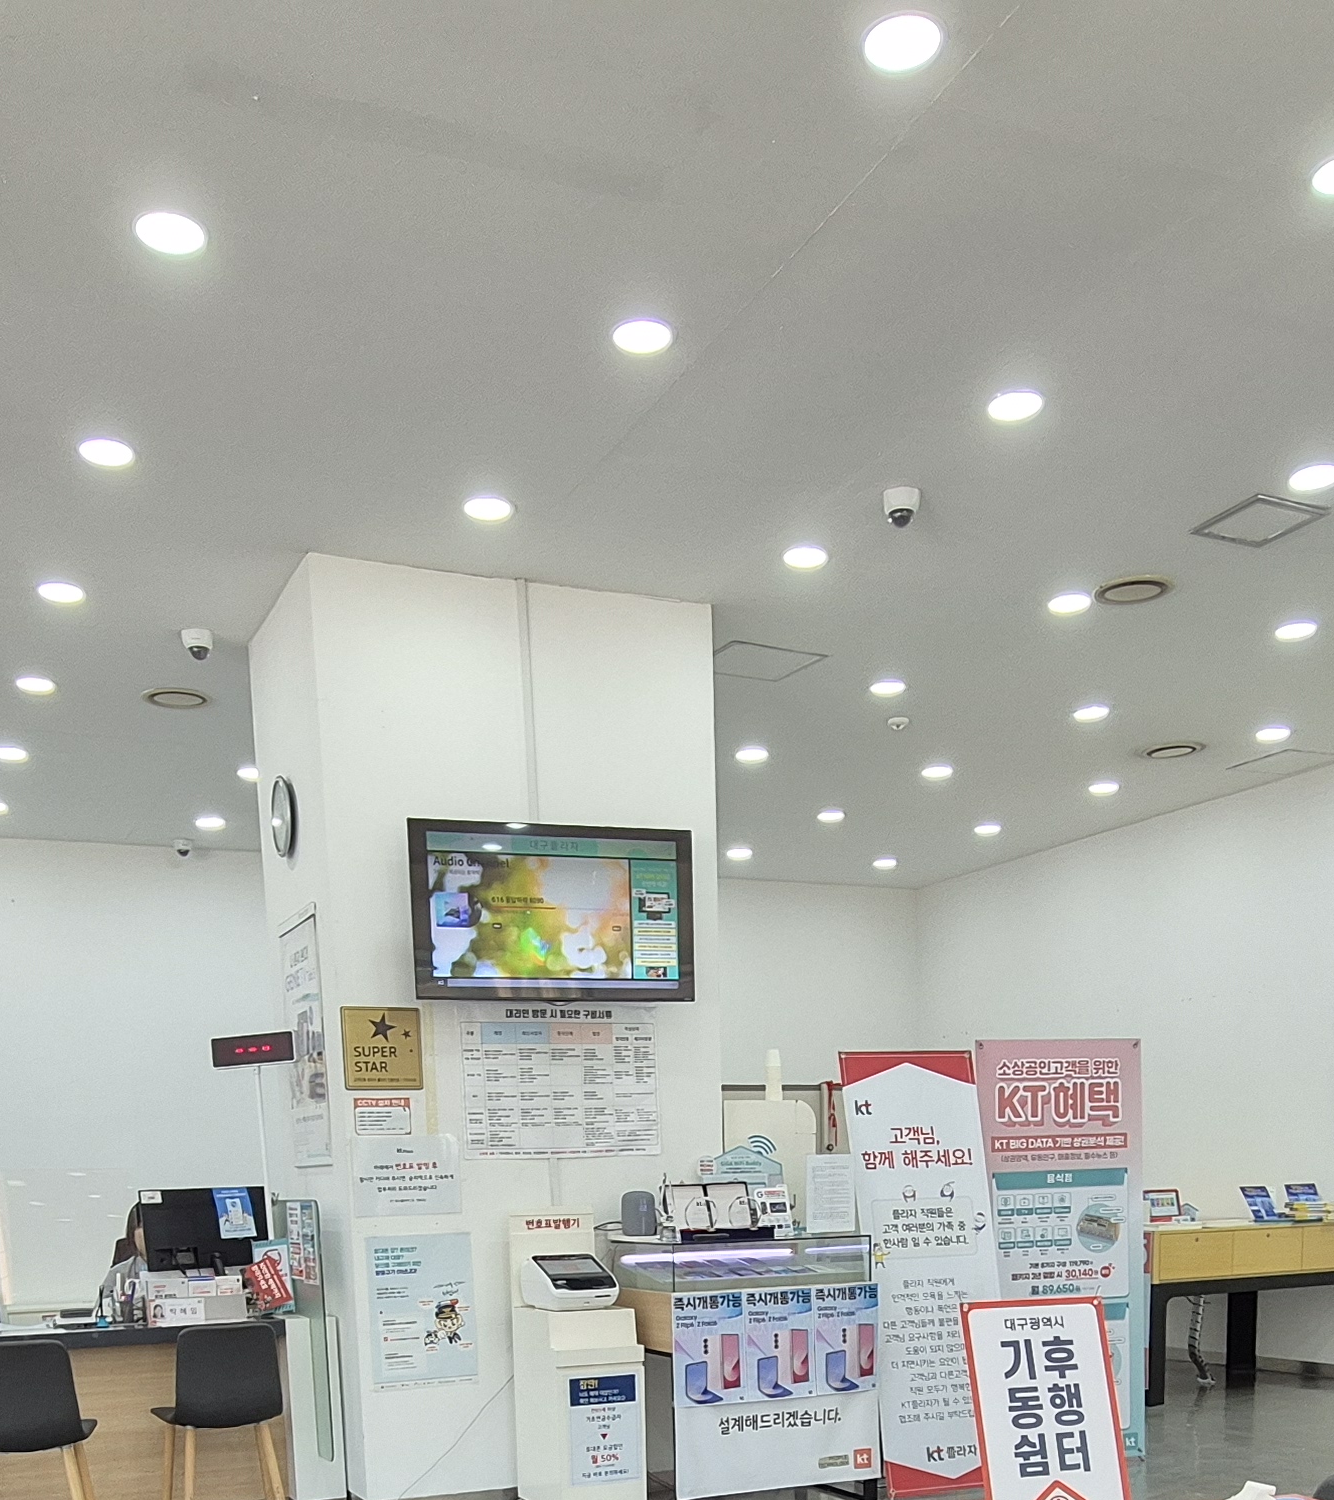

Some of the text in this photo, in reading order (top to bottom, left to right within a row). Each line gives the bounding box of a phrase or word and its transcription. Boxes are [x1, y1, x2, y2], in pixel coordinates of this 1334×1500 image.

[433, 856, 464, 868] Audio
[353, 1046, 398, 1058] SUPER
[354, 1061, 389, 1073] STAR
[997, 1059, 1119, 1077] 소상공인고객을 위한
[357, 1099, 377, 1107] CCTV
[854, 1100, 873, 1116] kt
[997, 1081, 1120, 1120] KT 혜택
[889, 1126, 940, 1146] 고객님,
[994, 1139, 1008, 1150] KT
[1009, 1139, 1027, 1149] BIG
[1028, 1138, 1054, 1149] DATA
[861, 1148, 973, 1170] 함께 해주세요!
[892, 1206, 954, 1221] 플라자 직원들은
[882, 1220, 966, 1235] 고객 여러분의 가족 중
[923, 1236, 932, 1247] 수
[934, 1234, 970, 1246] 있습니다.
[746, 1289, 812, 1307] 즉시개통가능
[815, 1284, 878, 1302] 즉시개통가능
[673, 1295, 742, 1311] 즉시개통가능
[883, 1321, 898, 1330] 다른
[1004, 1315, 1065, 1331] 대구광역시
[905, 1344, 944, 1356] 도움이 되지
[1000, 1335, 1079, 1381] 기후
[953, 1397, 960, 1405] 수
[1007, 1383, 1085, 1430] 동행
[718, 1407, 842, 1435] 설계해드리겠습니다.
[1125, 1436, 1137, 1446] kt
[601, 1453, 620, 1463] 50%
[856, 1453, 869, 1464] kt
[926, 1445, 945, 1462] kt
[1013, 1429, 1092, 1478] 쉼터
